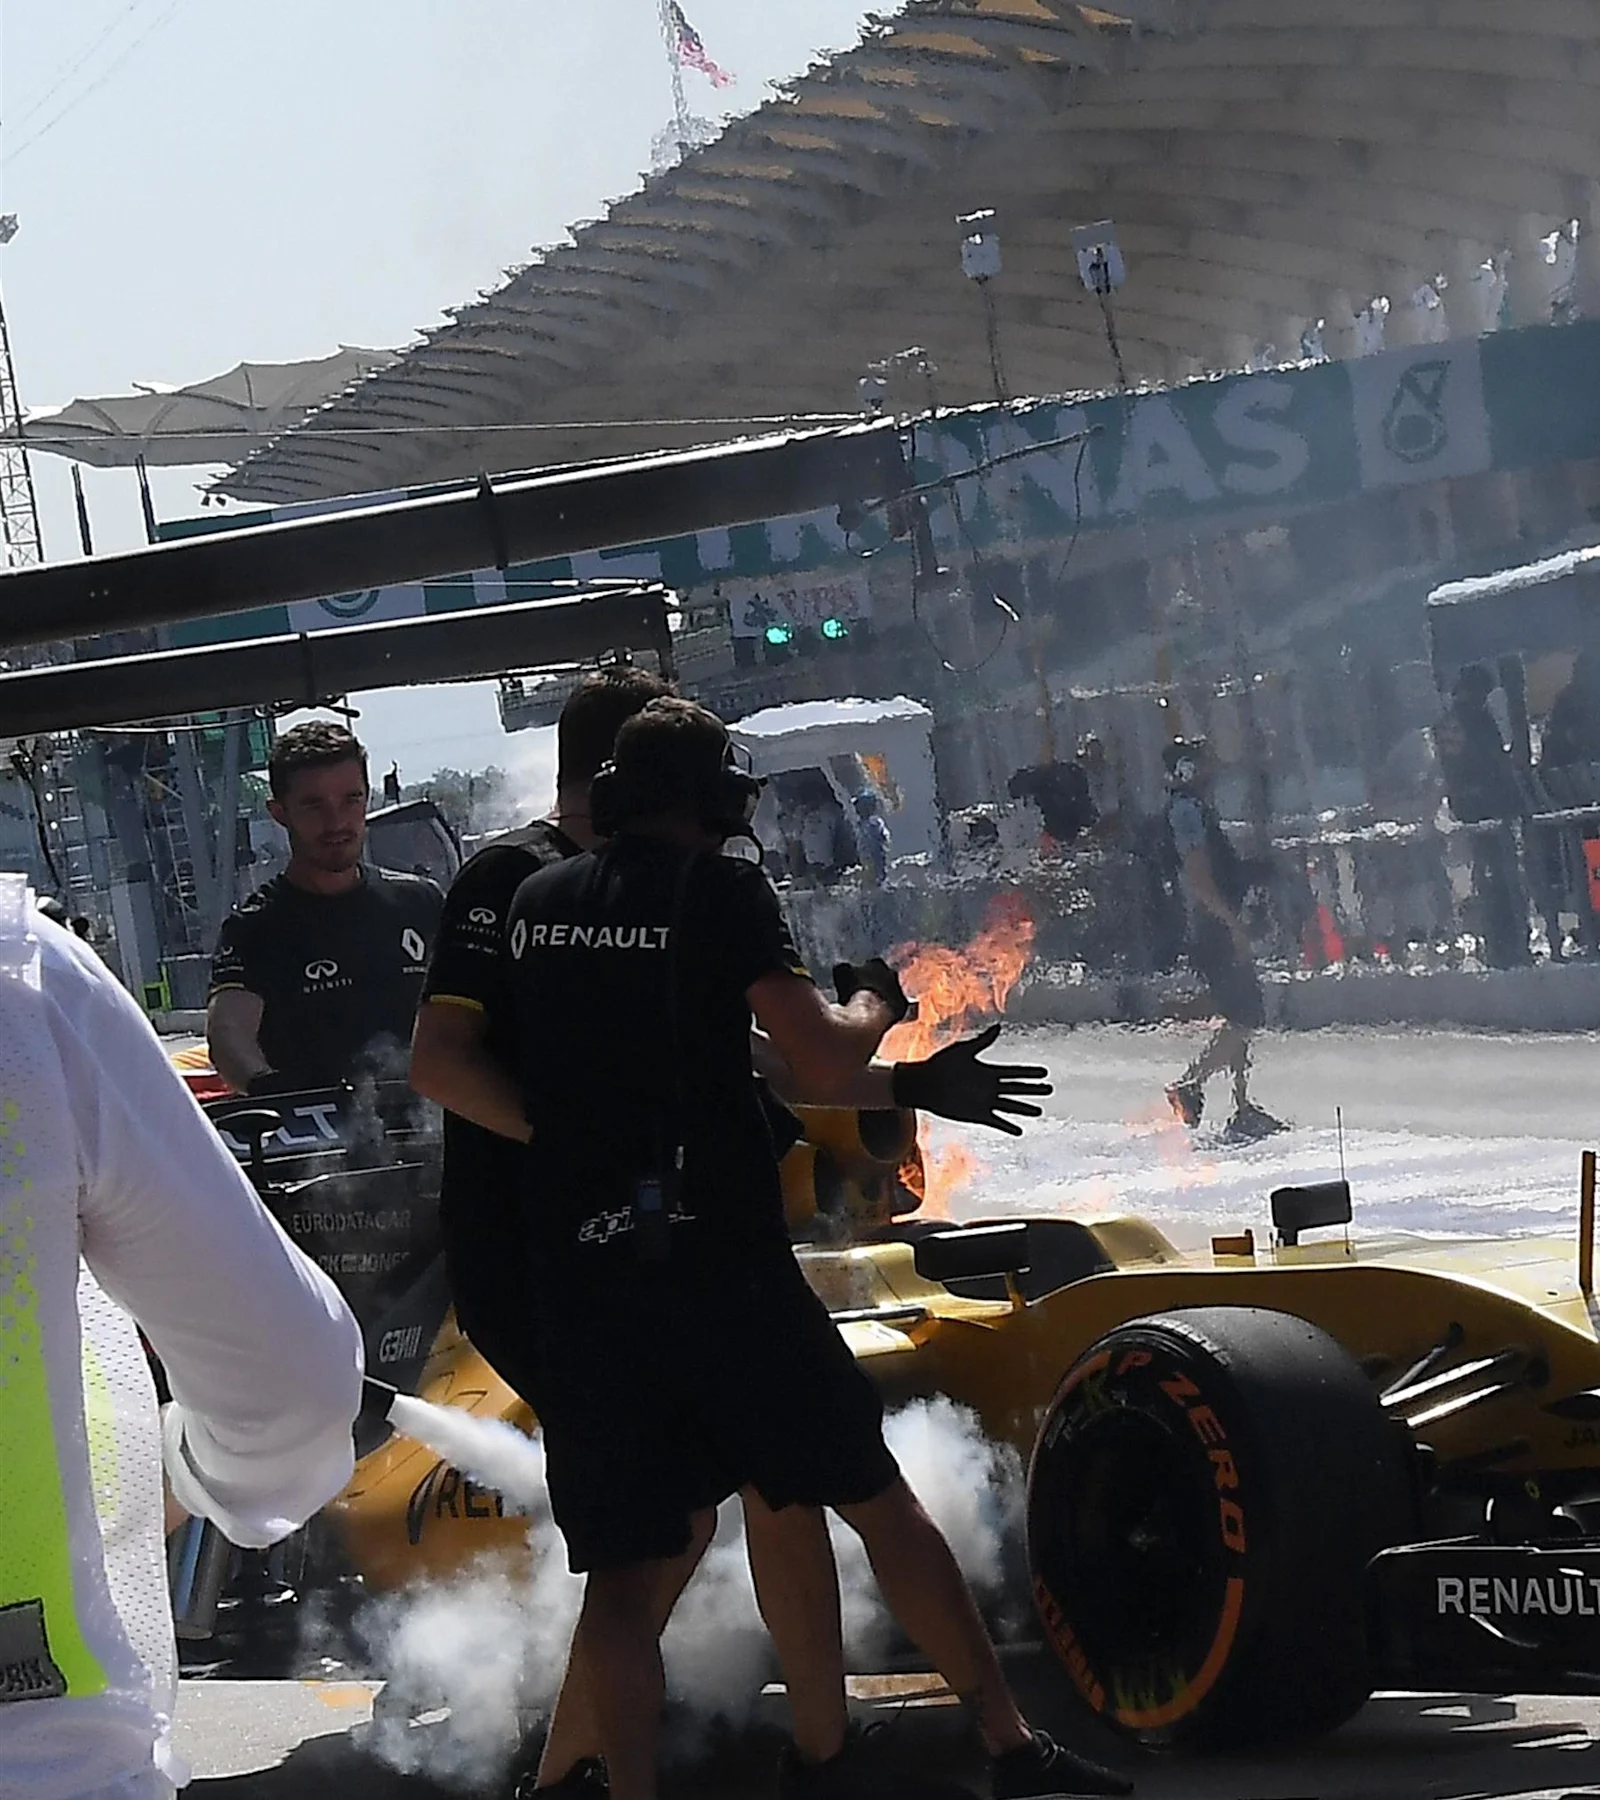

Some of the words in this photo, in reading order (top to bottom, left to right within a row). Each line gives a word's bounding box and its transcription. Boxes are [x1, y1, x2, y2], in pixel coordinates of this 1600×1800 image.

[531, 923, 670, 950] RENAULT
[292, 1210, 412, 1234] EURODATACAR
[1115, 1350, 1152, 1375] P
[1159, 1371, 1244, 1554] ZERO
